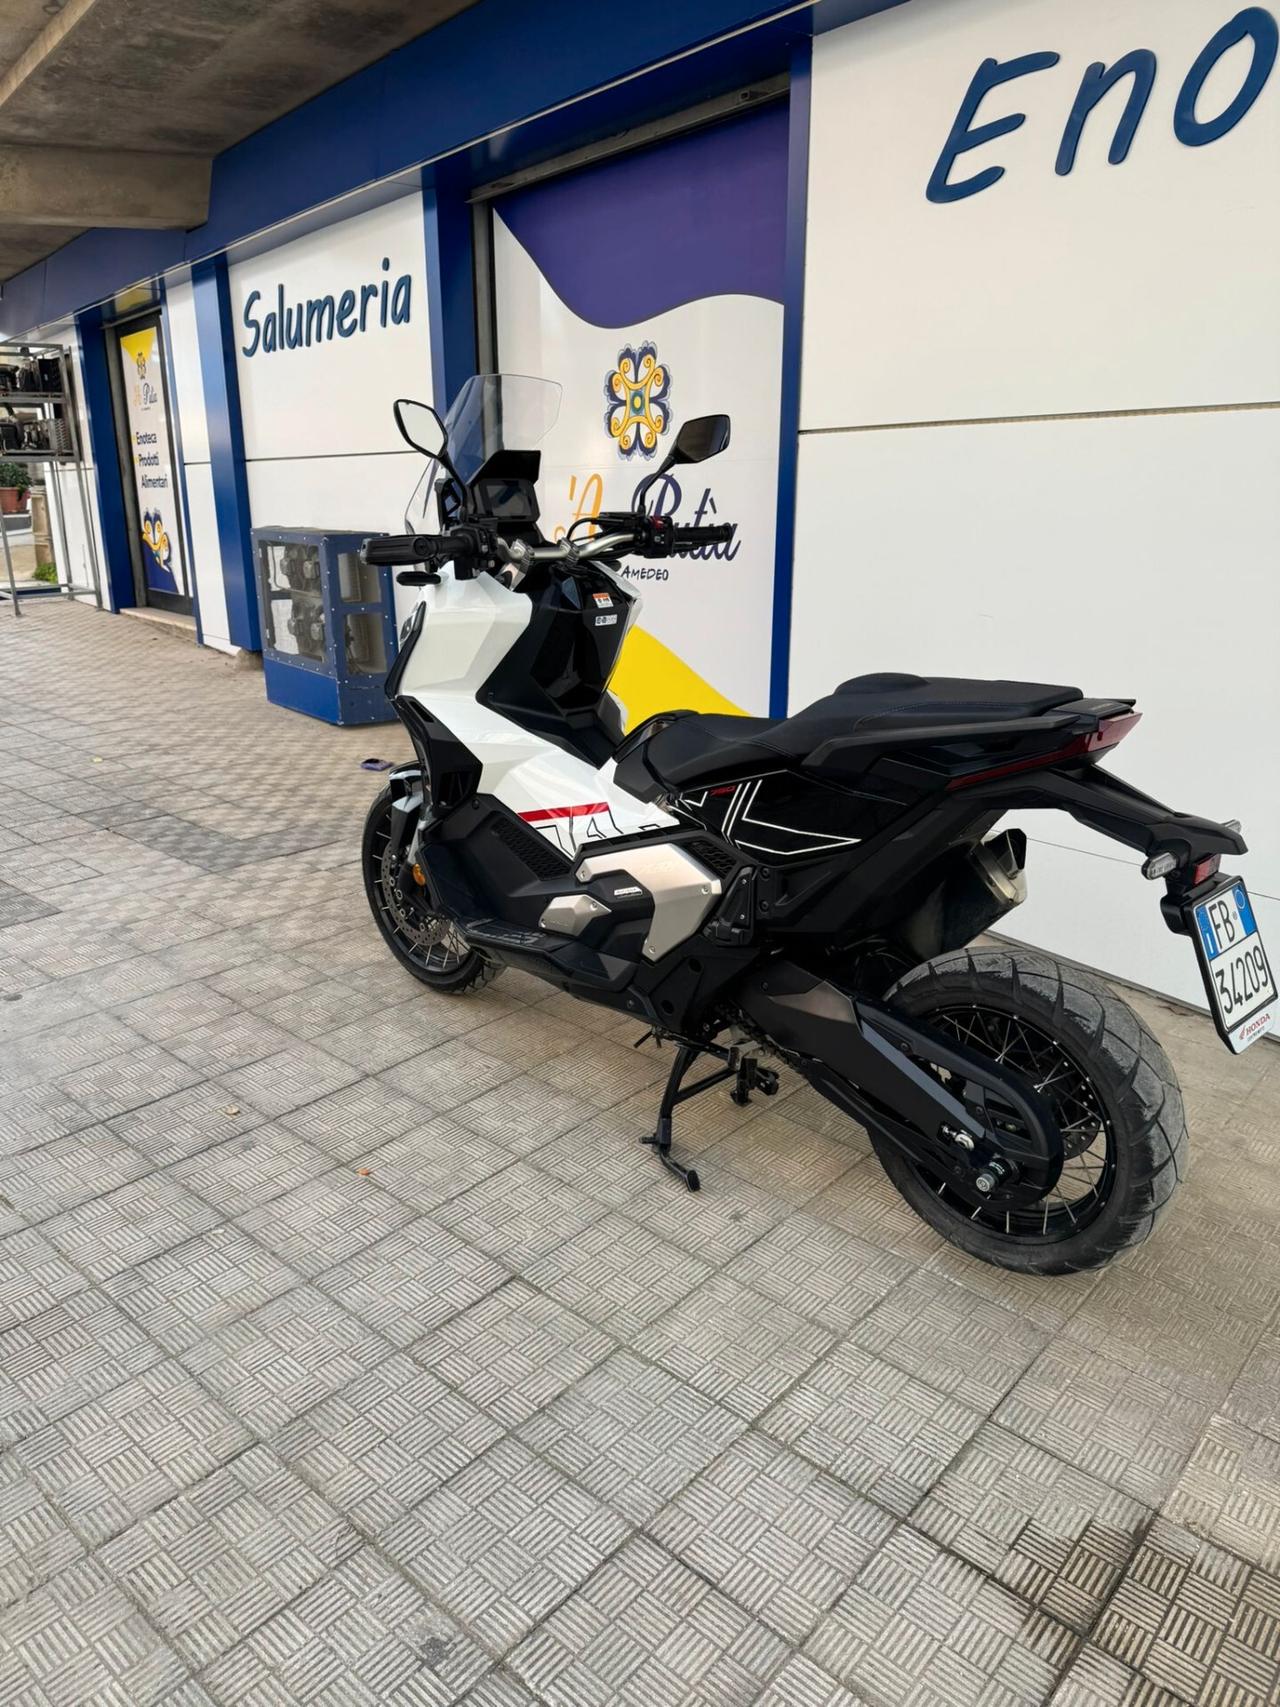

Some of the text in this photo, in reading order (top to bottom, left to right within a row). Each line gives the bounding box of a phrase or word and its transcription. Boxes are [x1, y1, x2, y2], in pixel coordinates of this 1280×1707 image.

[926, 6, 1279, 204] Eno
[242, 257, 412, 357] Salumeria
[136, 431, 157, 445] Enoteca
[139, 452, 160, 467] Prodotti
[141, 473, 169, 489] Alimentari
[620, 565, 669, 580] AMEDEO
[1208, 900, 1235, 950] FB
[1215, 945, 1269, 1014] 34209
[1246, 1013, 1271, 1036] HONDA
